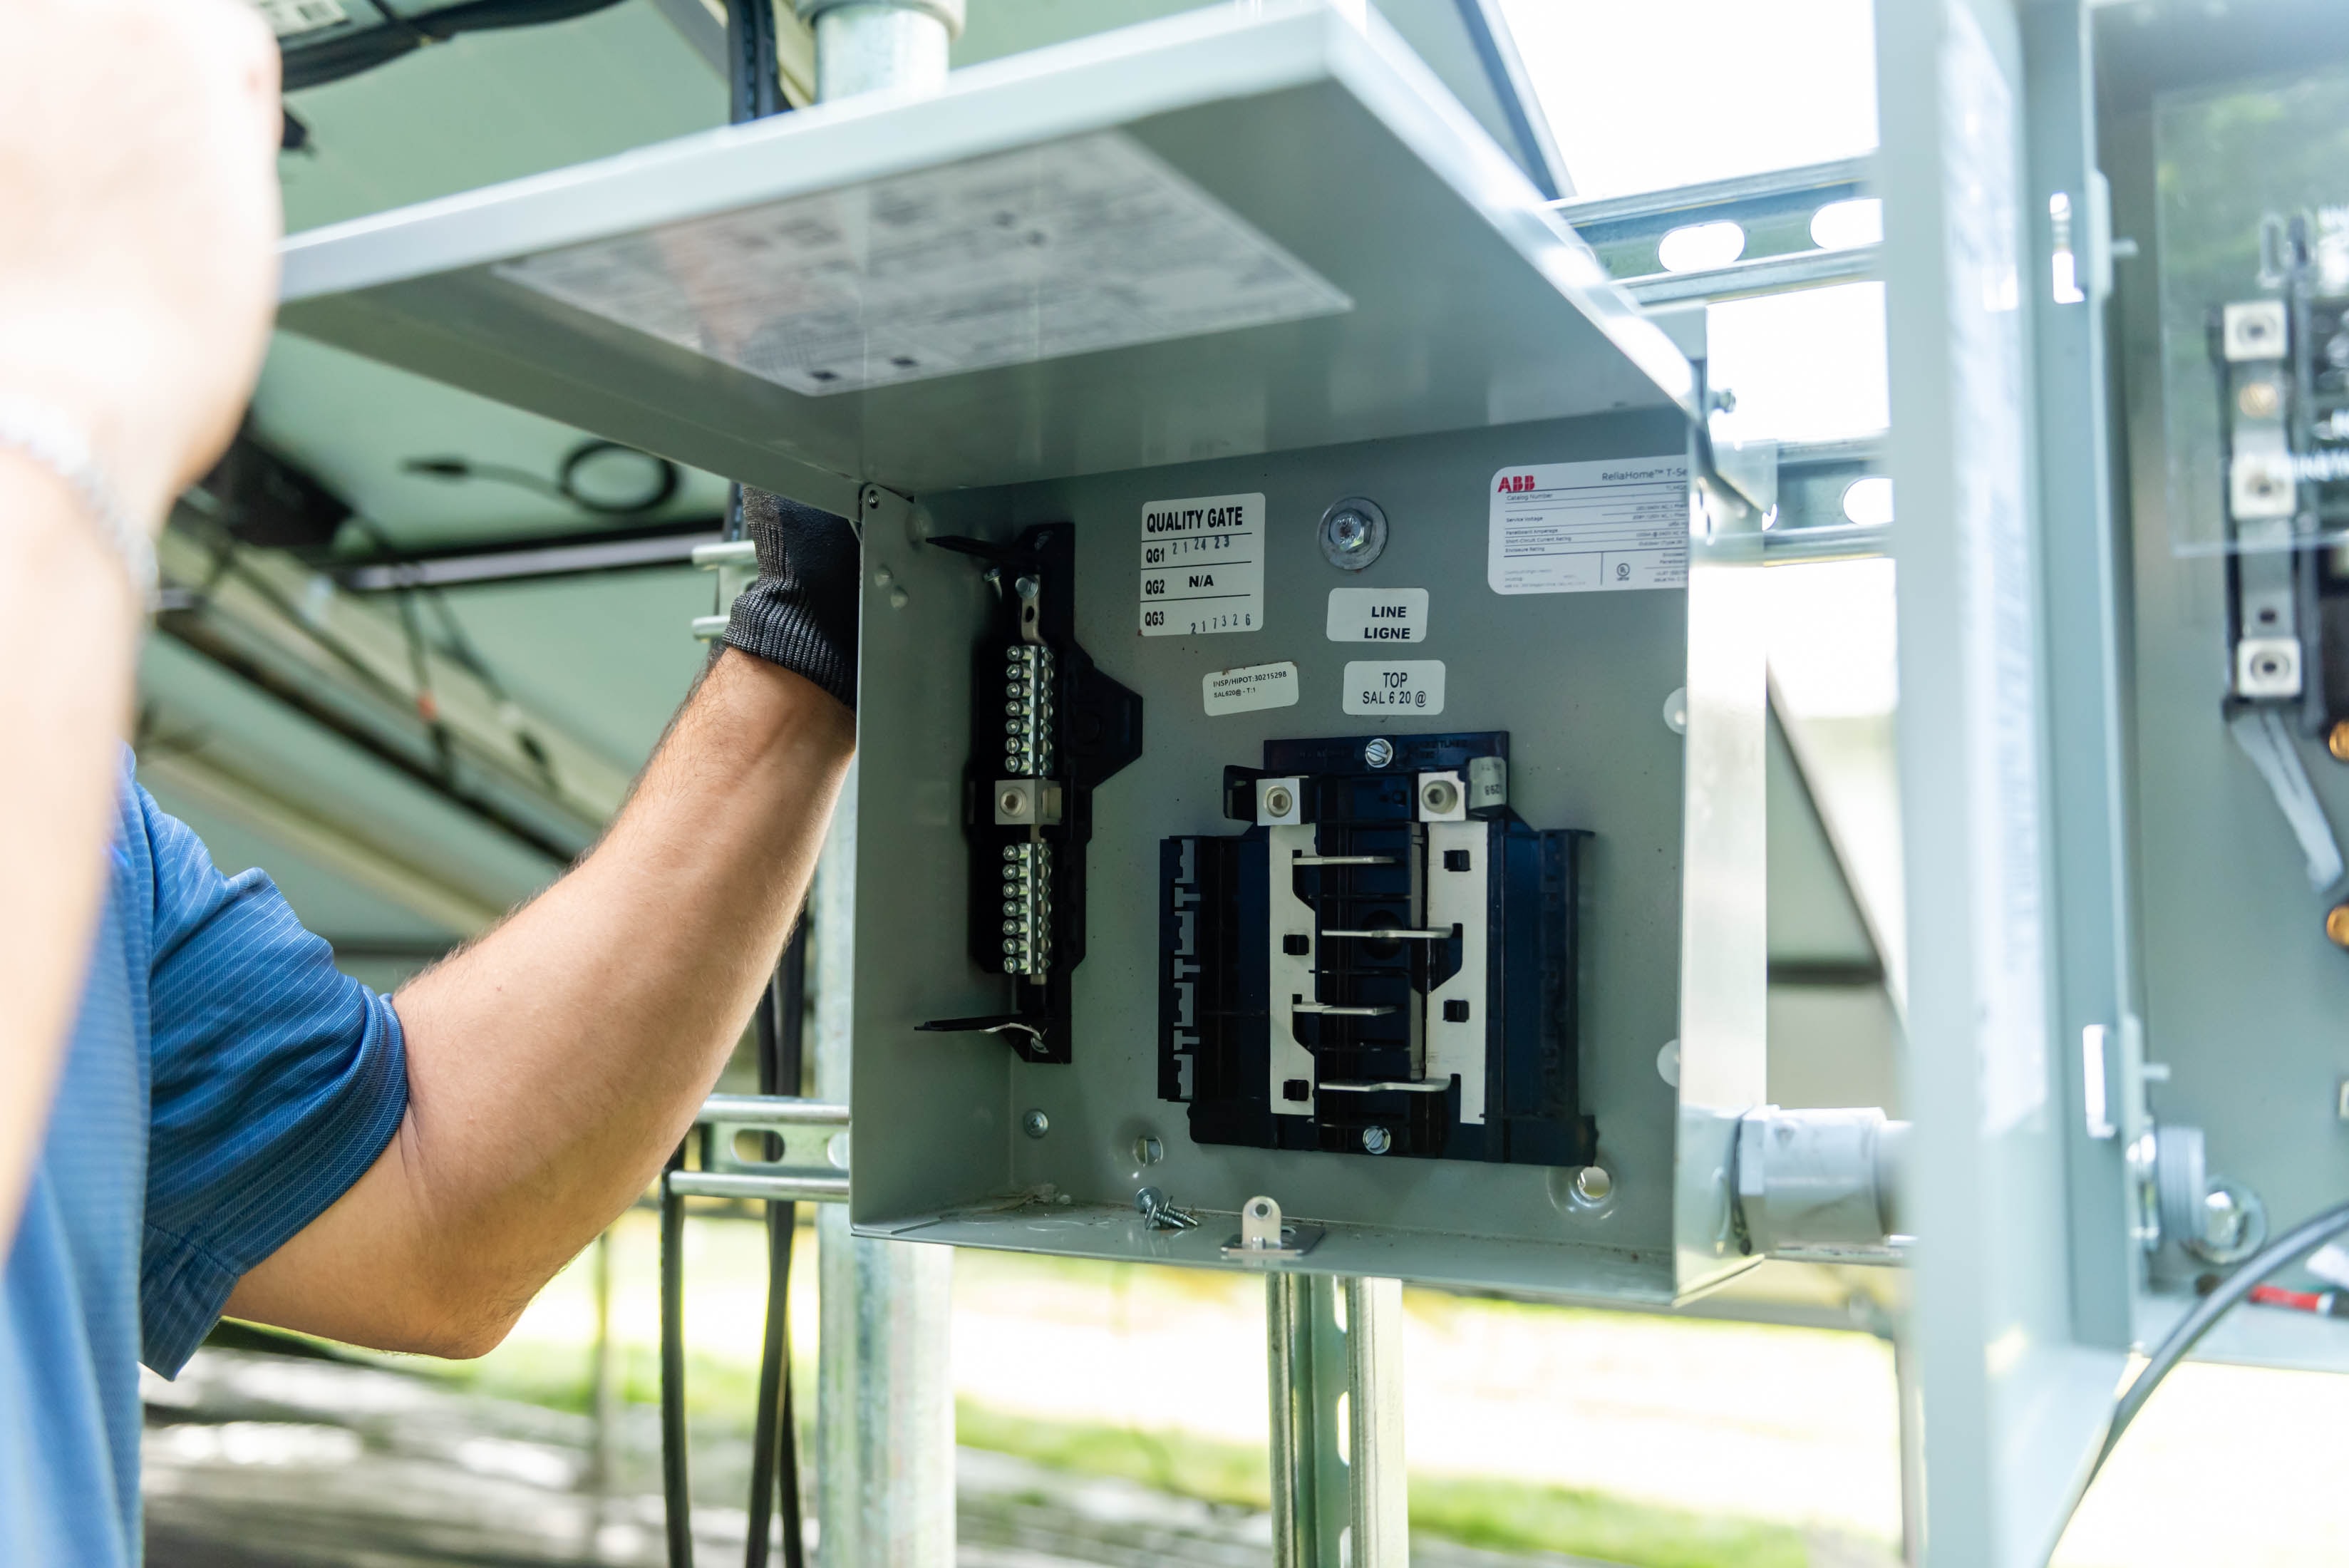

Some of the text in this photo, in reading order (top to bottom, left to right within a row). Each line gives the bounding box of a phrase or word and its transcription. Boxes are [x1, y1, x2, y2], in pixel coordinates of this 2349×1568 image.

[1497, 475, 1536, 492] ABB
[1147, 506, 1243, 534] QUALITY GATE
[1145, 547, 1165, 564] QG1
[1145, 574, 1214, 596] QG2 N/A
[1145, 610, 1165, 627] QG3
[1371, 606, 1407, 618] LINE
[1364, 627, 1410, 639] LIGNE
[1383, 672, 1408, 688] TOP
[1363, 691, 1385, 704] SAL
[1399, 691, 1411, 704] 20
[1415, 690, 1427, 708] @
